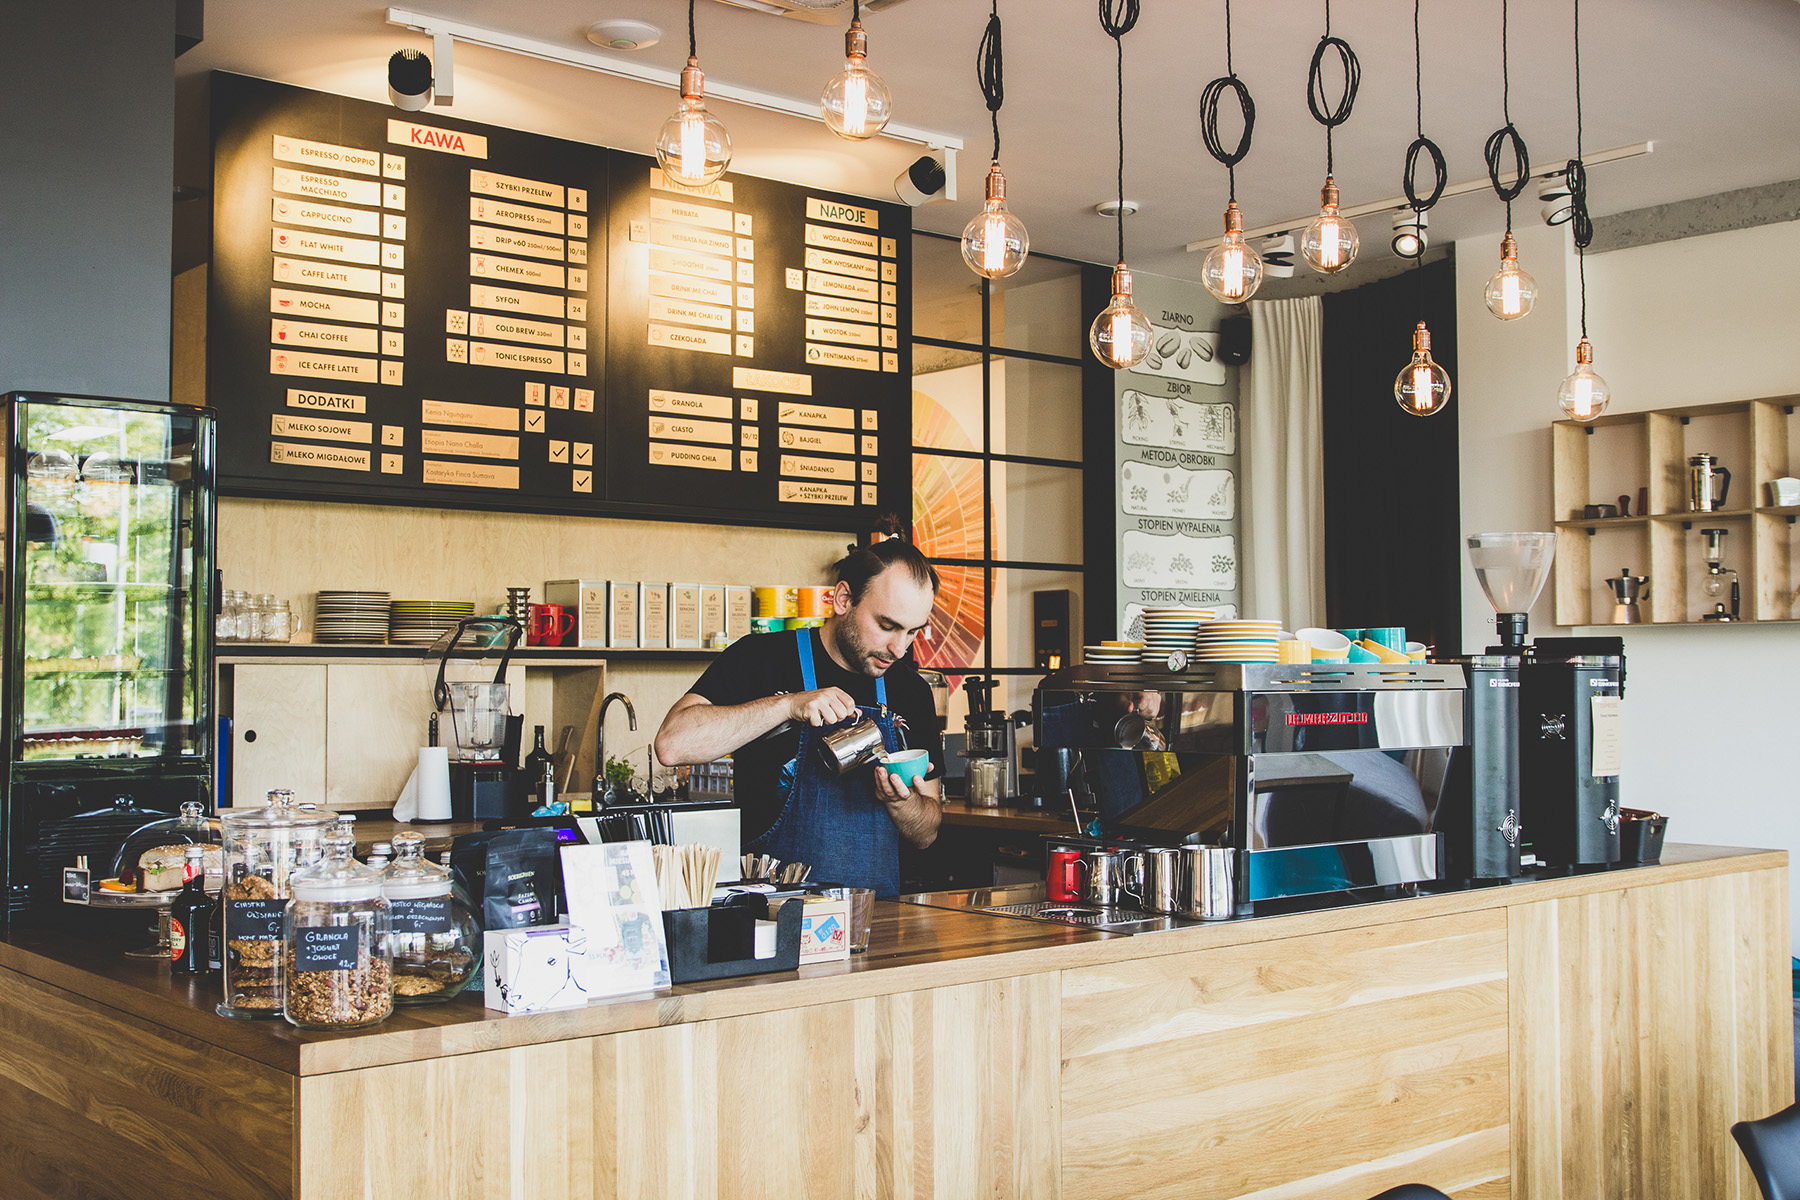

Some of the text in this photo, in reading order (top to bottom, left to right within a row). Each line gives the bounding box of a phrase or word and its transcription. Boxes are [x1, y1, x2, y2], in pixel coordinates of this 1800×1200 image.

[411, 127, 465, 151] KAWA
[387, 162, 401, 171] 6/8
[300, 175, 339, 187] ESPRESSO
[301, 185, 348, 198] MACCHIATO
[496, 182, 553, 198] SZYBKI PRZELEW
[392, 193, 398, 201] 8
[300, 210, 352, 224] CAPPUCCINO
[496, 210, 535, 222] AEROPRESS
[672, 208, 699, 219] HERBATA
[820, 204, 866, 223] NAPOJE
[496, 236, 512, 244] DRIP
[672, 234, 698, 244] HERBATA
[708, 240, 730, 249] ZIMNO
[822, 234, 874, 248] WODA GAZOWANA
[300, 240, 344, 252] FLAT WHITE
[569, 247, 586, 256] 10/18
[389, 252, 397, 260] 10
[301, 269, 348, 282] CAFFE LATTE
[496, 264, 541, 278] CHEMEX 500ml
[671, 284, 691, 293] DRINK
[702, 288, 718, 296] CHAI
[823, 281, 856, 291] LEMONIADA
[300, 300, 331, 311] MOCHA
[496, 296, 520, 305] SYFON
[389, 311, 397, 319] 13
[667, 308, 687, 316] DRINK
[698, 312, 714, 320] CHAI
[840, 306, 860, 314] LEMON
[1162, 311, 1194, 326] ZIARNO
[496, 324, 514, 333] COLD
[516, 327, 536, 335] BREW
[823, 328, 848, 336] WOSTOK
[299, 331, 349, 342] CHAI COFFEE
[670, 334, 707, 345] CZEKOLADA
[389, 340, 397, 348] 13
[496, 352, 552, 365] TONIC ESPRESSO
[824, 352, 856, 362] FENTIMANS
[299, 361, 359, 374] ICE CAFFE LATTE
[1167, 382, 1192, 395] ZBIOR
[298, 394, 355, 409] DODATKI
[671, 399, 703, 409] GRANOLA
[425, 408, 442, 416] Kenia
[799, 411, 827, 420] KANAPKA
[288, 423, 352, 435] MLEKO SOJOWE
[671, 426, 694, 434] CIASTO
[742, 432, 758, 441] 10/12
[799, 436, 822, 445] BAJGIEL
[424, 438, 484, 449] Etiopia Nano Challa
[287, 450, 366, 465] MLEKO MIGDAŁOWE
[671, 452, 717, 463] PUDDING CHIA
[1141, 450, 1216, 466] METODA OBROBKI
[426, 469, 454, 478] Kostaryka
[472, 472, 495, 480] Sumava
[799, 464, 835, 474] ŚNIADANKO
[800, 486, 828, 494] KANAPKA
[1138, 519, 1221, 534] STOPIEN WYPALENIA
[1141, 590, 1221, 602] STOPIEN ZMIELENIA
[305, 931, 349, 943] GRANOLA
[311, 944, 341, 954] JOGURT
